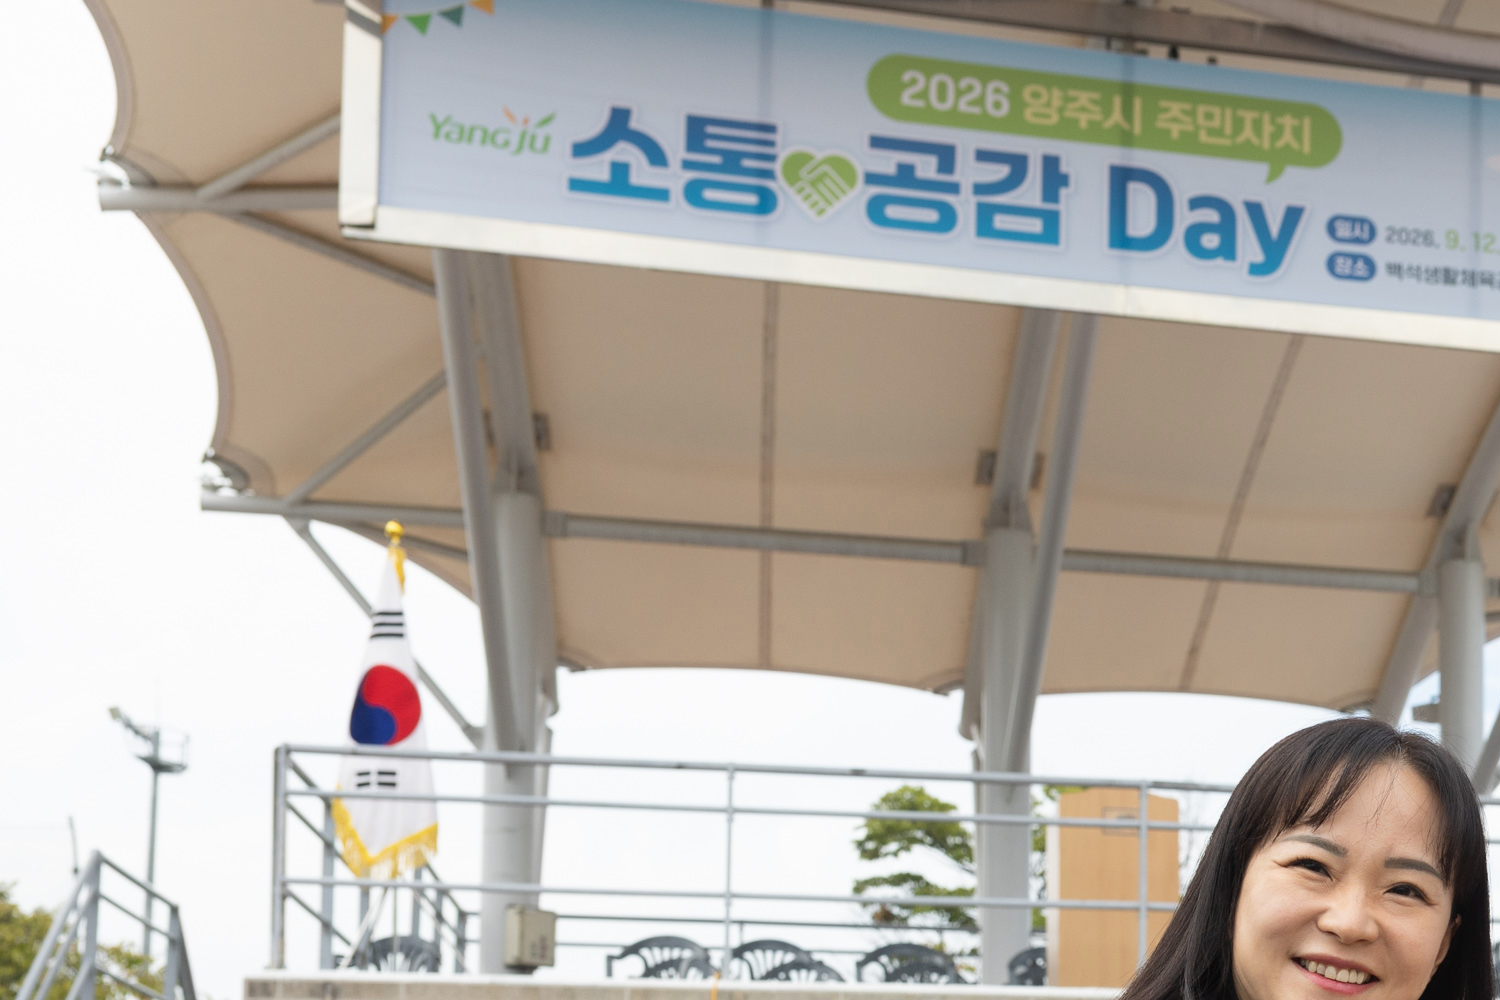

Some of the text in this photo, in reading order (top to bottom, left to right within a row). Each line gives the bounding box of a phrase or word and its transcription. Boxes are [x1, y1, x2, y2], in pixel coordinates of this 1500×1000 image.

[900, 69, 1312, 155] 2026 양주시 주민자치
[568, 106, 1306, 277] 소통 공감 Day
[1333, 218, 1371, 241] 일시
[1332, 255, 1371, 278] 장소
